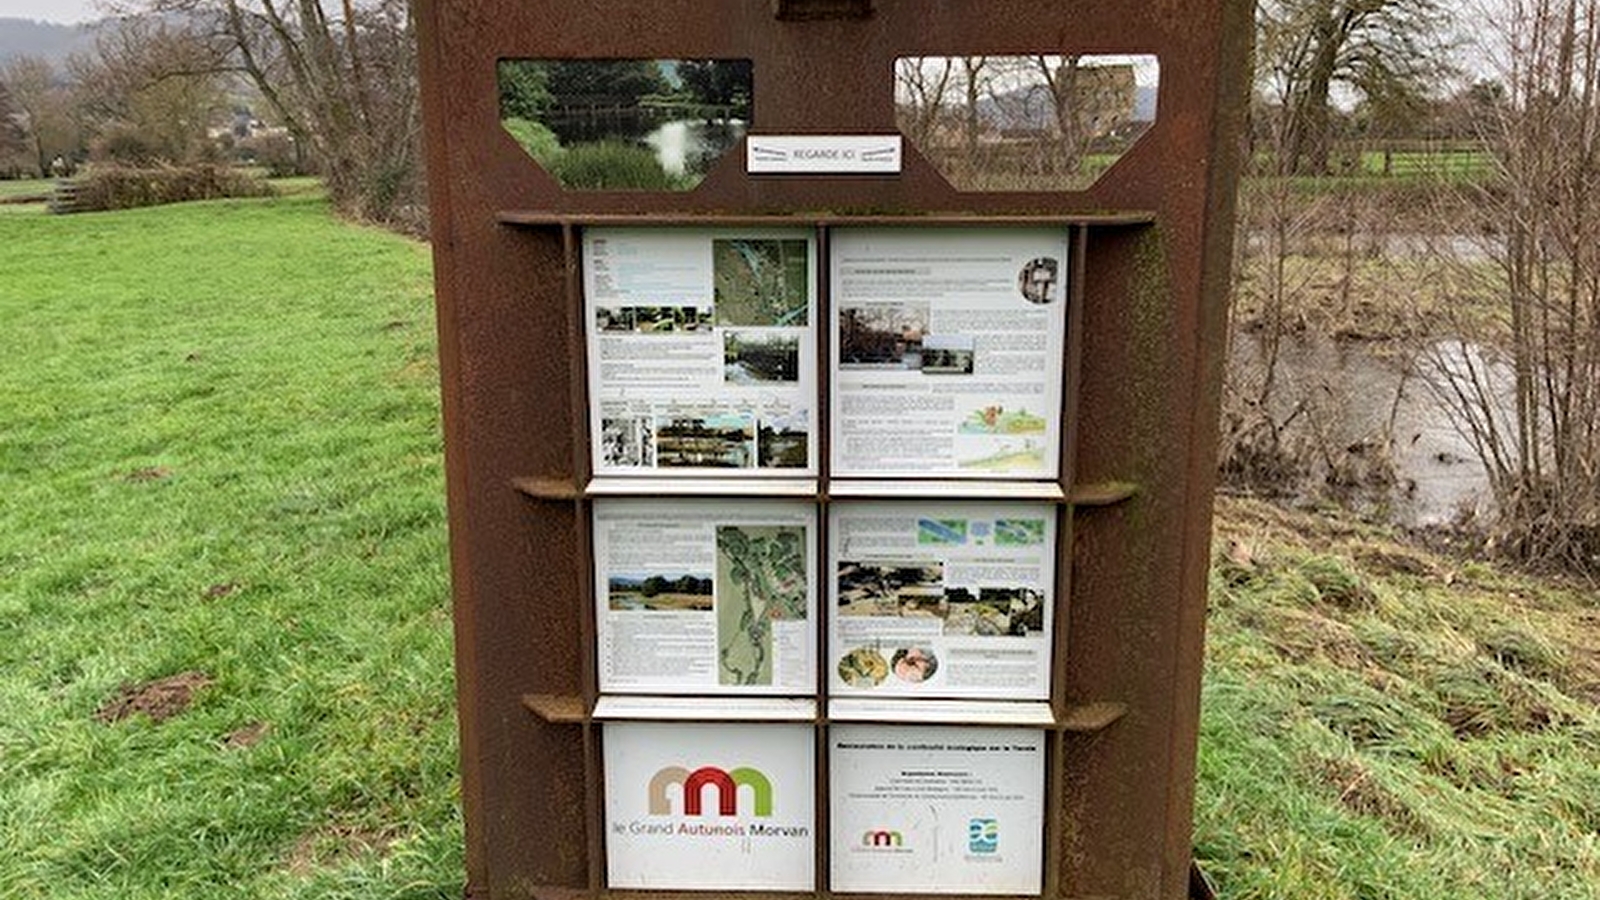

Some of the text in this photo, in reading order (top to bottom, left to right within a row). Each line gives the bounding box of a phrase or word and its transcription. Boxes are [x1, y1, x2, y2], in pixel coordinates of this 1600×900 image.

[613, 821, 809, 837] le Grand Autunois Morvan
